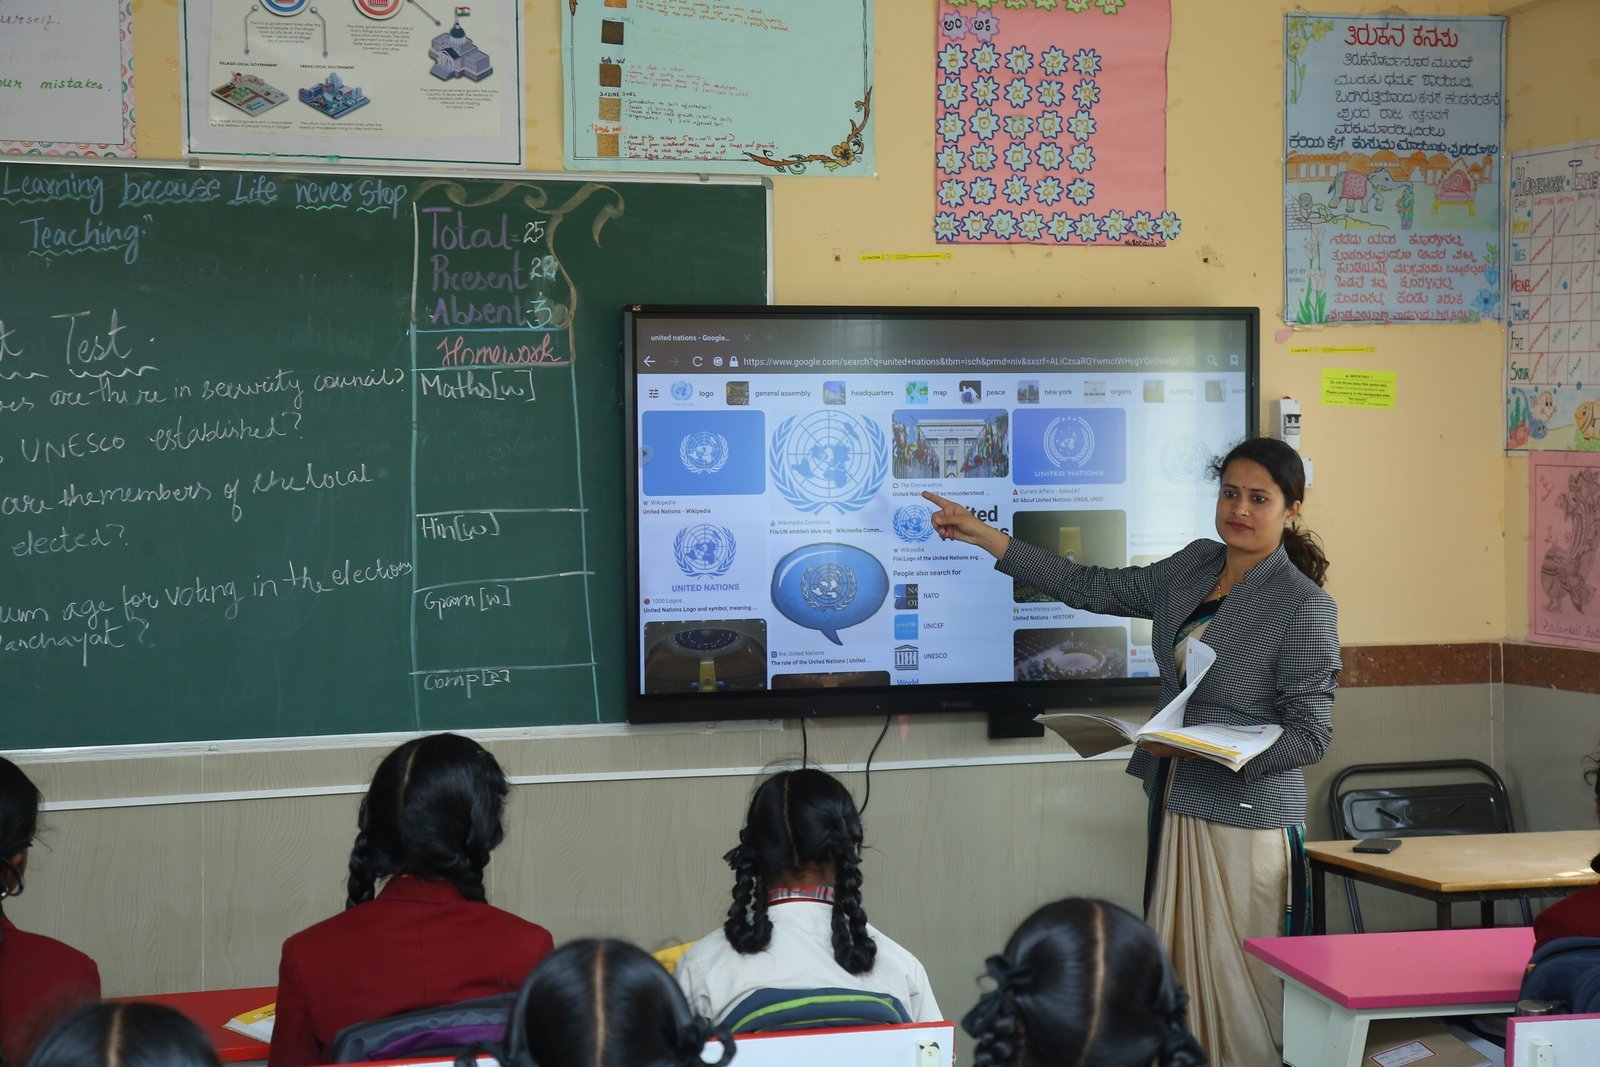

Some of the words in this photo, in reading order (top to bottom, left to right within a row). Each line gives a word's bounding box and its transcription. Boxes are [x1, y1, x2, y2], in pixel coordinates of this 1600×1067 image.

[40, 77, 111, 92] mistakes.
[2, 172, 104, 214] Learning
[122, 173, 220, 201] because
[235, 174, 277, 202] Life
[295, 180, 353, 203] never
[357, 180, 408, 219] Stop
[523, 221, 547, 244] 25
[431, 250, 529, 293] Present
[432, 294, 528, 326] Absent
[1511, 331, 1525, 350] FRI
[436, 332, 561, 367] Homework
[174, 379, 192, 400] in
[699, 390, 714, 398] logo
[755, 390, 779, 398] general
[780, 389, 811, 398] assembly
[851, 389, 894, 397] headquarters
[1057, 389, 1072, 397] york
[224, 478, 243, 522] of
[650, 499, 676, 507] Wikipedia
[686, 507, 711, 515] Wikipedia
[893, 570, 914, 578] People
[165, 576, 245, 620] voting
[253, 575, 278, 597] in
[283, 560, 335, 593] the
[672, 584, 702, 592] UNITED
[704, 583, 740, 591] NATIONS
